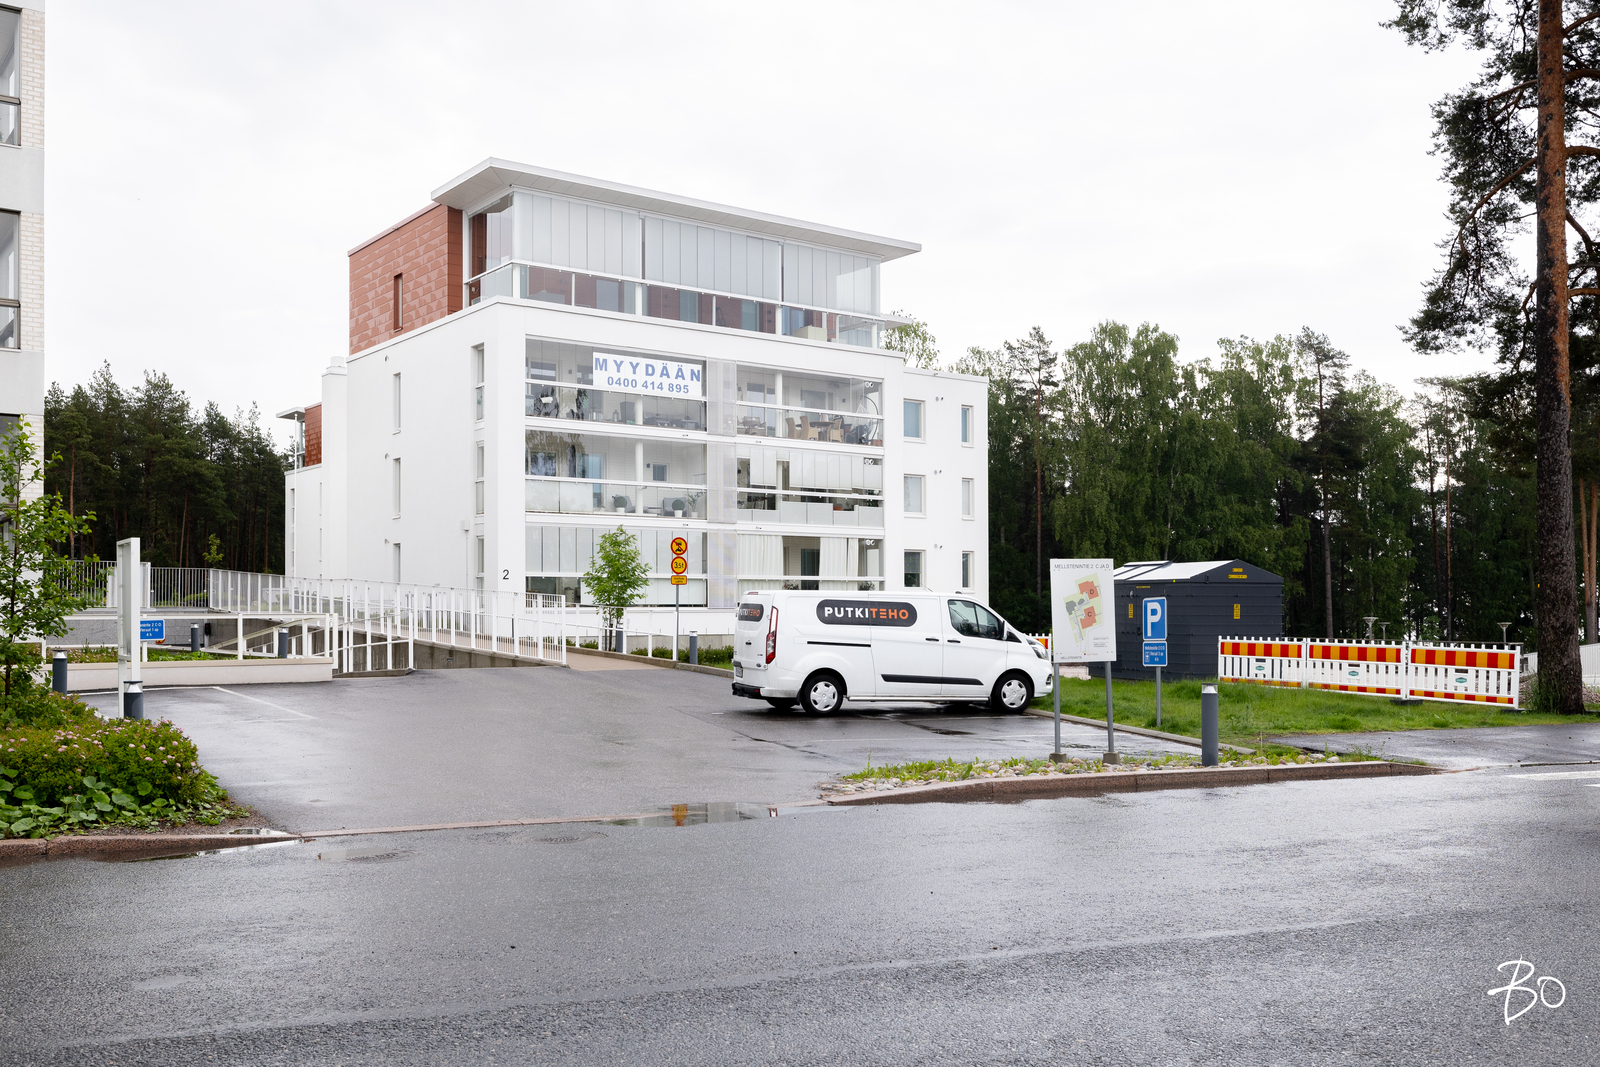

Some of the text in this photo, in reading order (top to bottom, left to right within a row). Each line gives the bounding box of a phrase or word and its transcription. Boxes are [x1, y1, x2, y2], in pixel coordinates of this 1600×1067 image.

[594, 357, 700, 382] MYYDÄÄN
[607, 376, 689, 394] 0400 414 895
[502, 569, 509, 580] 2
[824, 606, 909, 620] PUTKITEHO
[1146, 601, 1162, 637] P
